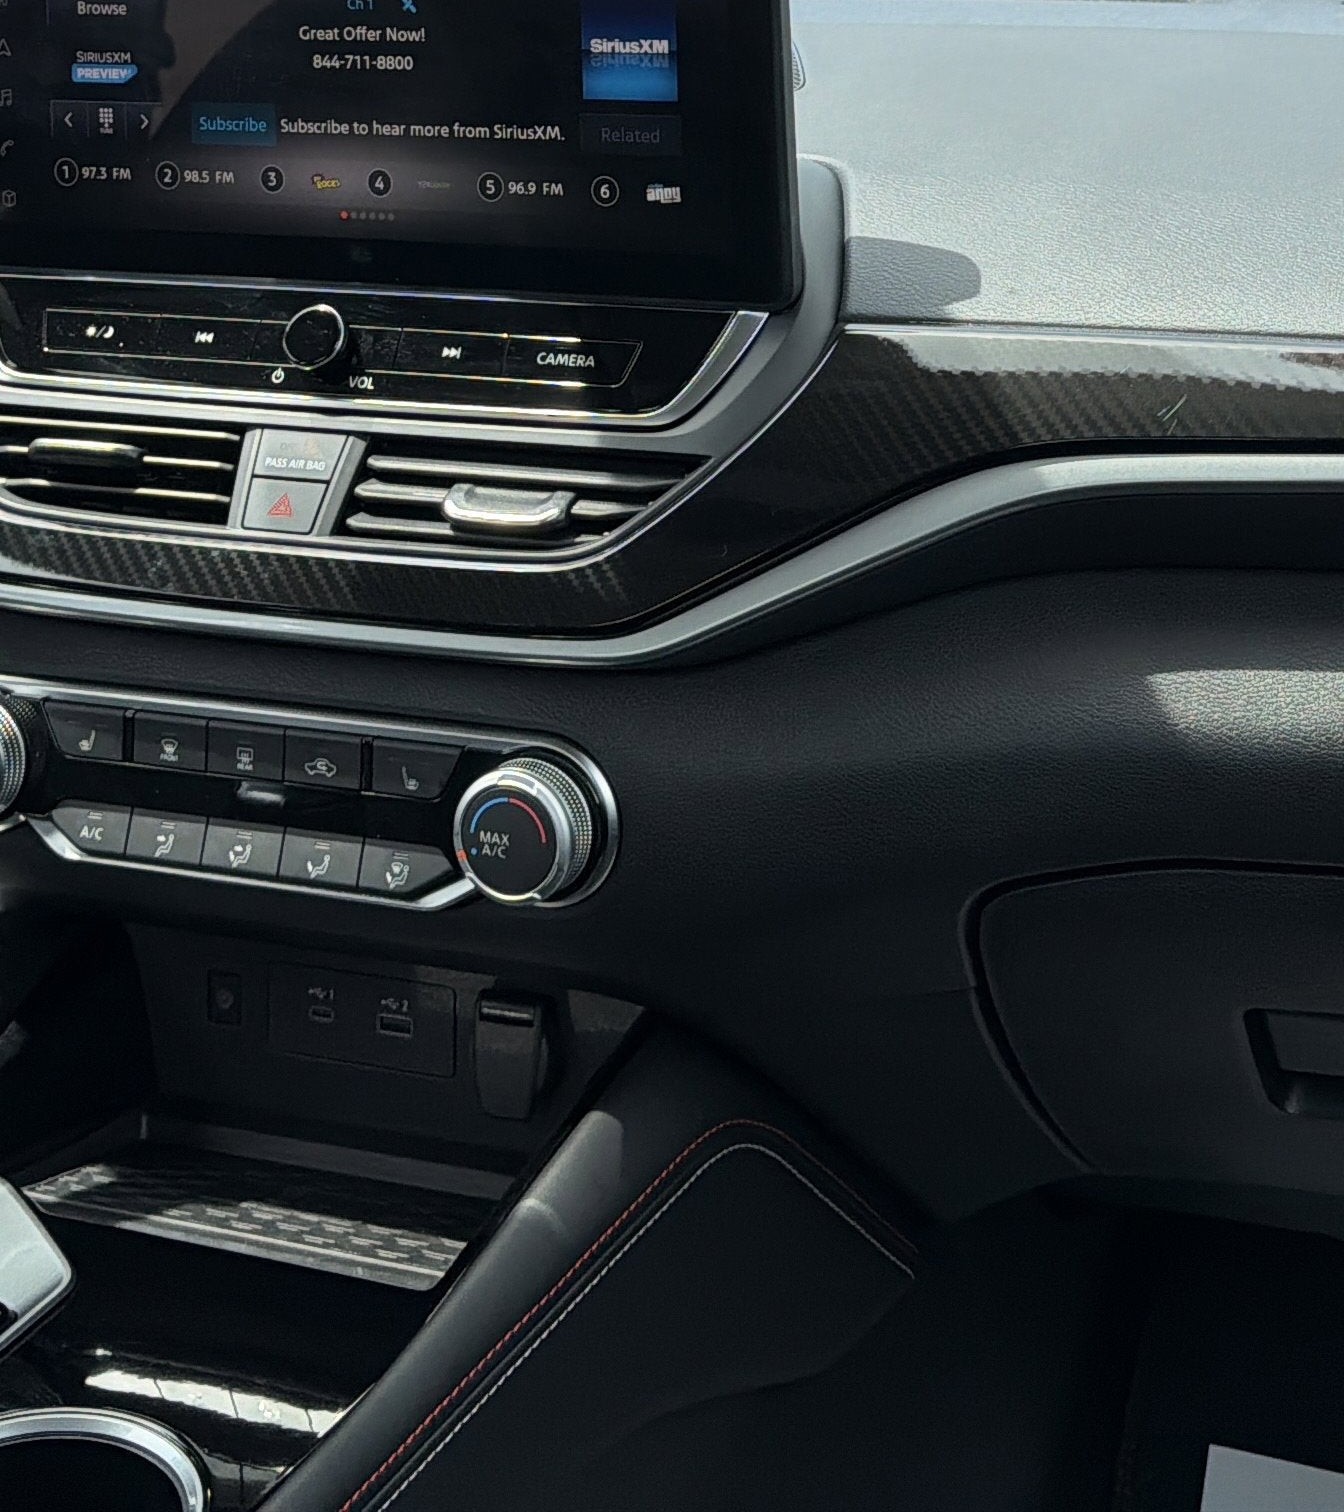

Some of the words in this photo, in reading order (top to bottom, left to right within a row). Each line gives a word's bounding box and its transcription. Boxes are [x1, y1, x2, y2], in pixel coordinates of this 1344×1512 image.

[77, 1, 127, 16] Browse
[299, 26, 340, 41] Great
[343, 26, 382, 42] Offer
[386, 27, 426, 42] Now!
[590, 38, 669, 54] SiriusXM
[76, 50, 132, 63] SIRIUSXM
[312, 54, 414, 71] 844-711-8800
[199, 116, 267, 132] Subscribe
[280, 118, 350, 134] Subscribe
[353, 122, 369, 135] to
[373, 120, 406, 136] hear
[410, 125, 449, 137] more
[453, 122, 489, 139] from
[493, 124, 566, 141] SiriusXM.
[601, 127, 660, 143] Related
[61, 165, 70, 179] 1
[81, 168, 107, 180] 97.3
[113, 168, 132, 181] FM
[163, 169, 172, 183] 2
[184, 170, 209, 183] 98.5
[216, 171, 235, 184] FM
[268, 172, 276, 186] 3
[375, 176, 384, 190] 4
[486, 180, 495, 195] 5
[508, 182, 536, 194] 96.9
[543, 183, 564, 196] FM
[600, 185, 610, 198] 6
[536, 351, 596, 369] CAMERA
[349, 376, 375, 391] VOL
[265, 456, 288, 468] PASS
[288, 459, 305, 469] AIR
[306, 460, 326, 471] BAG
[160, 754, 179, 762] FRONT
[236, 763, 253, 771] REAR
[79, 825, 104, 840] A/C
[480, 830, 510, 847] MAX
[482, 845, 506, 859] A/C
